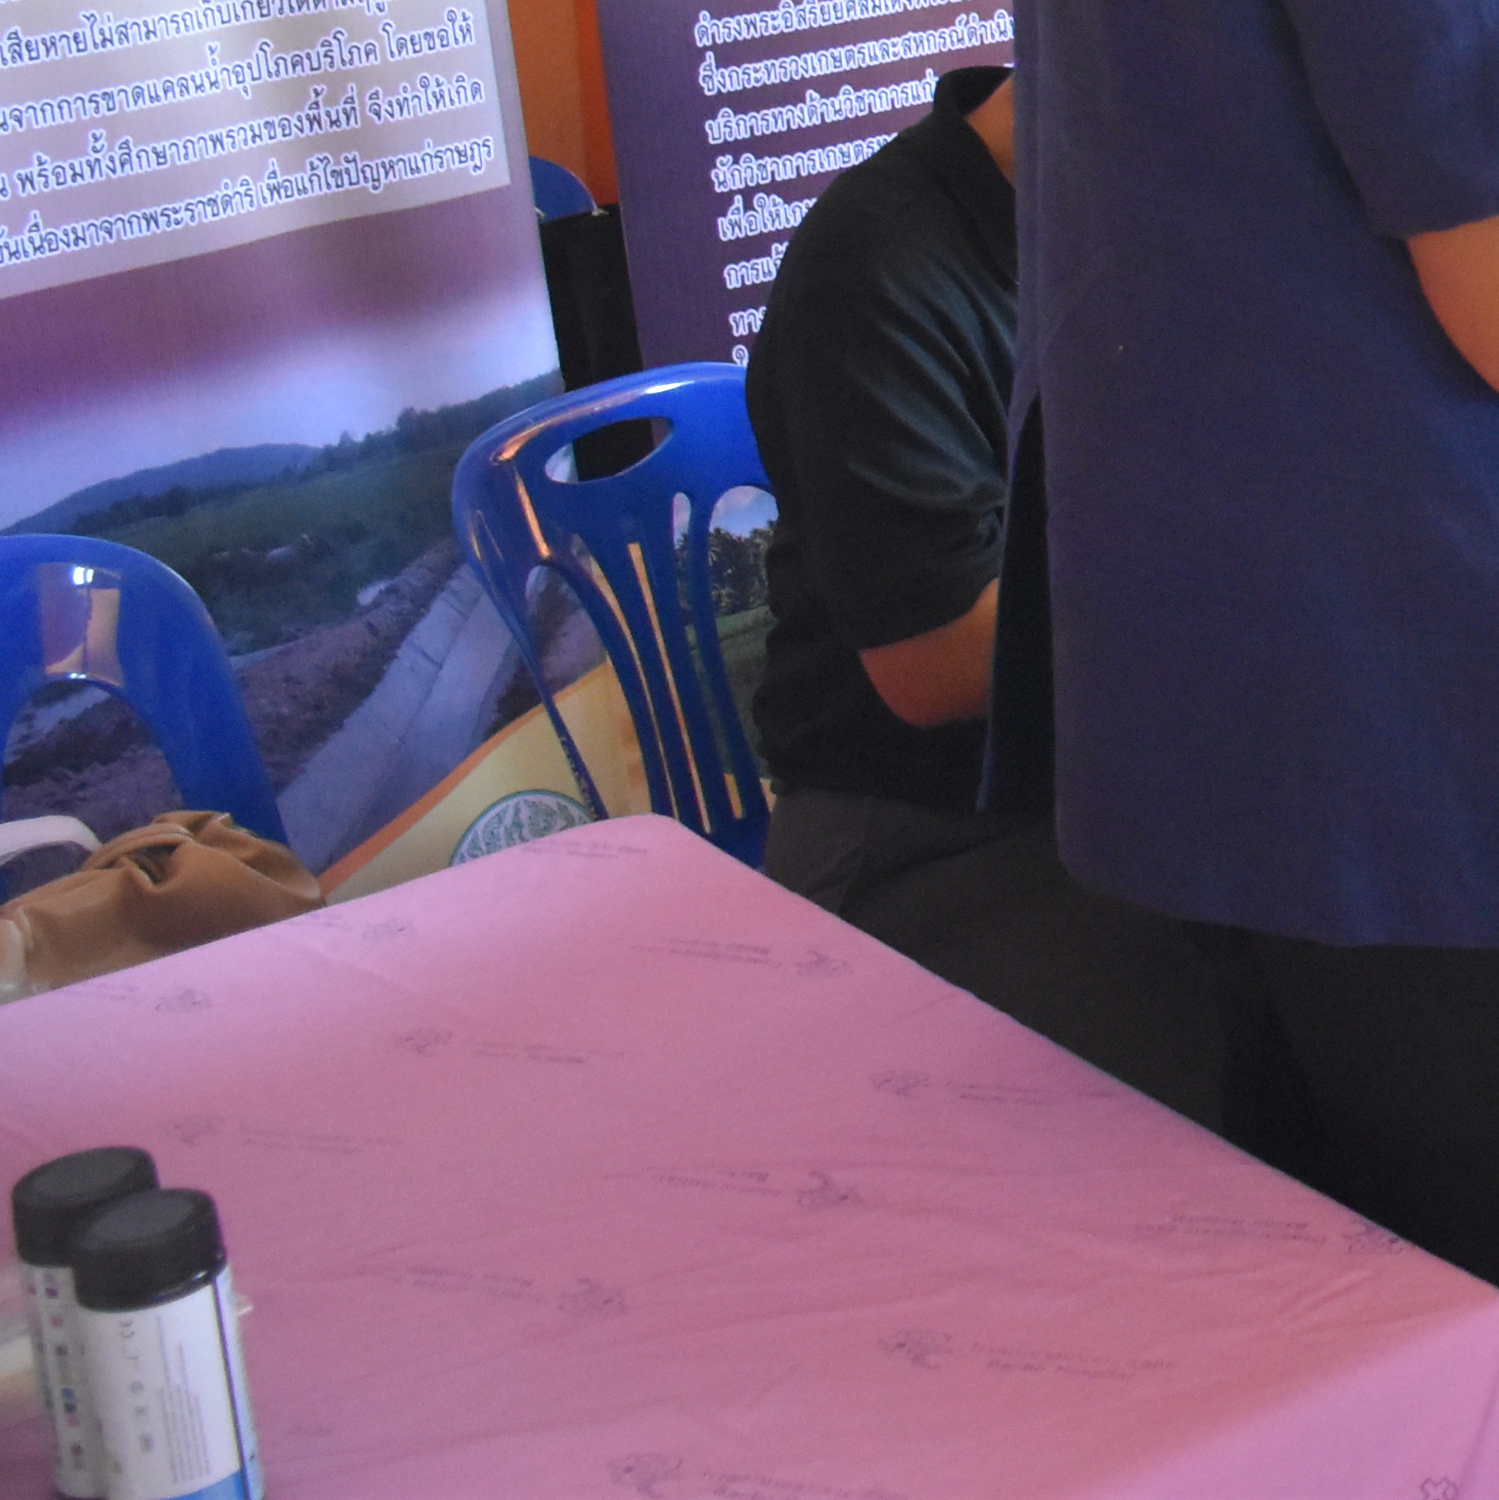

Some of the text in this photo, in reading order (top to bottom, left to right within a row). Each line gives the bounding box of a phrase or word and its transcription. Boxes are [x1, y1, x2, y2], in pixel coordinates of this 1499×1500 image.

[382, 8, 474, 59] โดยขอให้
[16, 85, 359, 194] พร้อมทั้งศึกษาภาพรวมของพื้นที่
[368, 74, 483, 123] จึงทำให้เกิด
